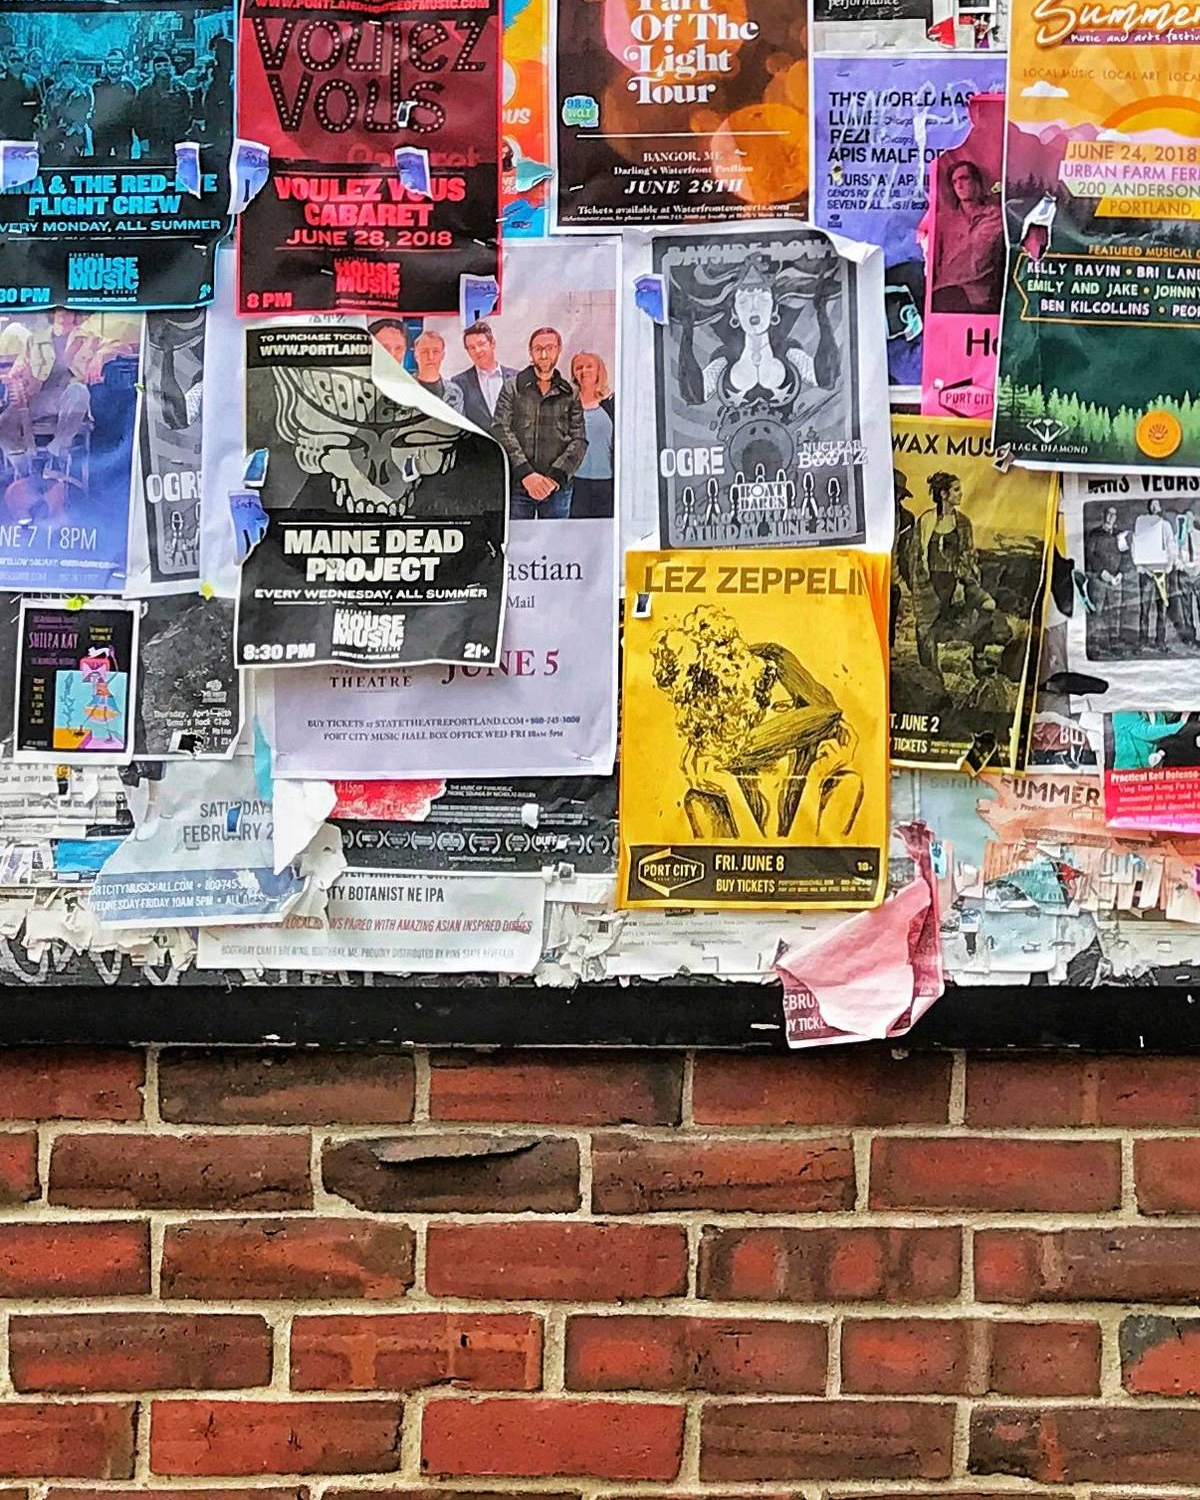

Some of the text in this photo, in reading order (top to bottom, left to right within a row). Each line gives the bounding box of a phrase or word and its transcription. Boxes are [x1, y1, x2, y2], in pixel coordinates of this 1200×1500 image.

[630, 13, 759, 41] Of The
[1071, 33, 1101, 43] music
[1107, 32, 1129, 44] and
[1135, 32, 1161, 43] arts
[623, 44, 732, 79] Light
[627, 77, 717, 104] Tour
[1068, 144, 1113, 161] JUNE
[1120, 145, 1147, 162] 24,
[1156, 146, 1197, 162] 2018
[1063, 164, 1118, 179] URBAN
[1122, 166, 1166, 180] FARM
[274, 178, 383, 202] VOULEZ
[625, 179, 743, 195] JUNE 28TH
[1078, 182, 1106, 195] 200
[1113, 183, 1200, 198] ANDERSON
[28, 195, 181, 216] FLIGHT CREW
[1109, 200, 1195, 217] PORTLAND,
[304, 203, 433, 227] CABARET
[43, 220, 221, 233] MONDAY, ALL SUMMER
[1089, 245, 1141, 256] FEATURED
[1145, 246, 1193, 259] MUSICAL
[660, 447, 725, 478] OGRE
[284, 530, 463, 554] MAINE DEAD
[307, 557, 440, 582] PROJECT
[255, 588, 487, 601] EVERY WEDNESDAY, ALL SUMMER
[330, 676, 412, 689] THEATRE
[324, 732, 347, 741] PORT
[349, 732, 369, 741] CITY
[371, 731, 399, 741] MUSIC
[402, 731, 427, 740] HALL
[429, 731, 448, 740] BOX
[449, 731, 482, 740] OFFICE
[485, 730, 507, 739] WED
